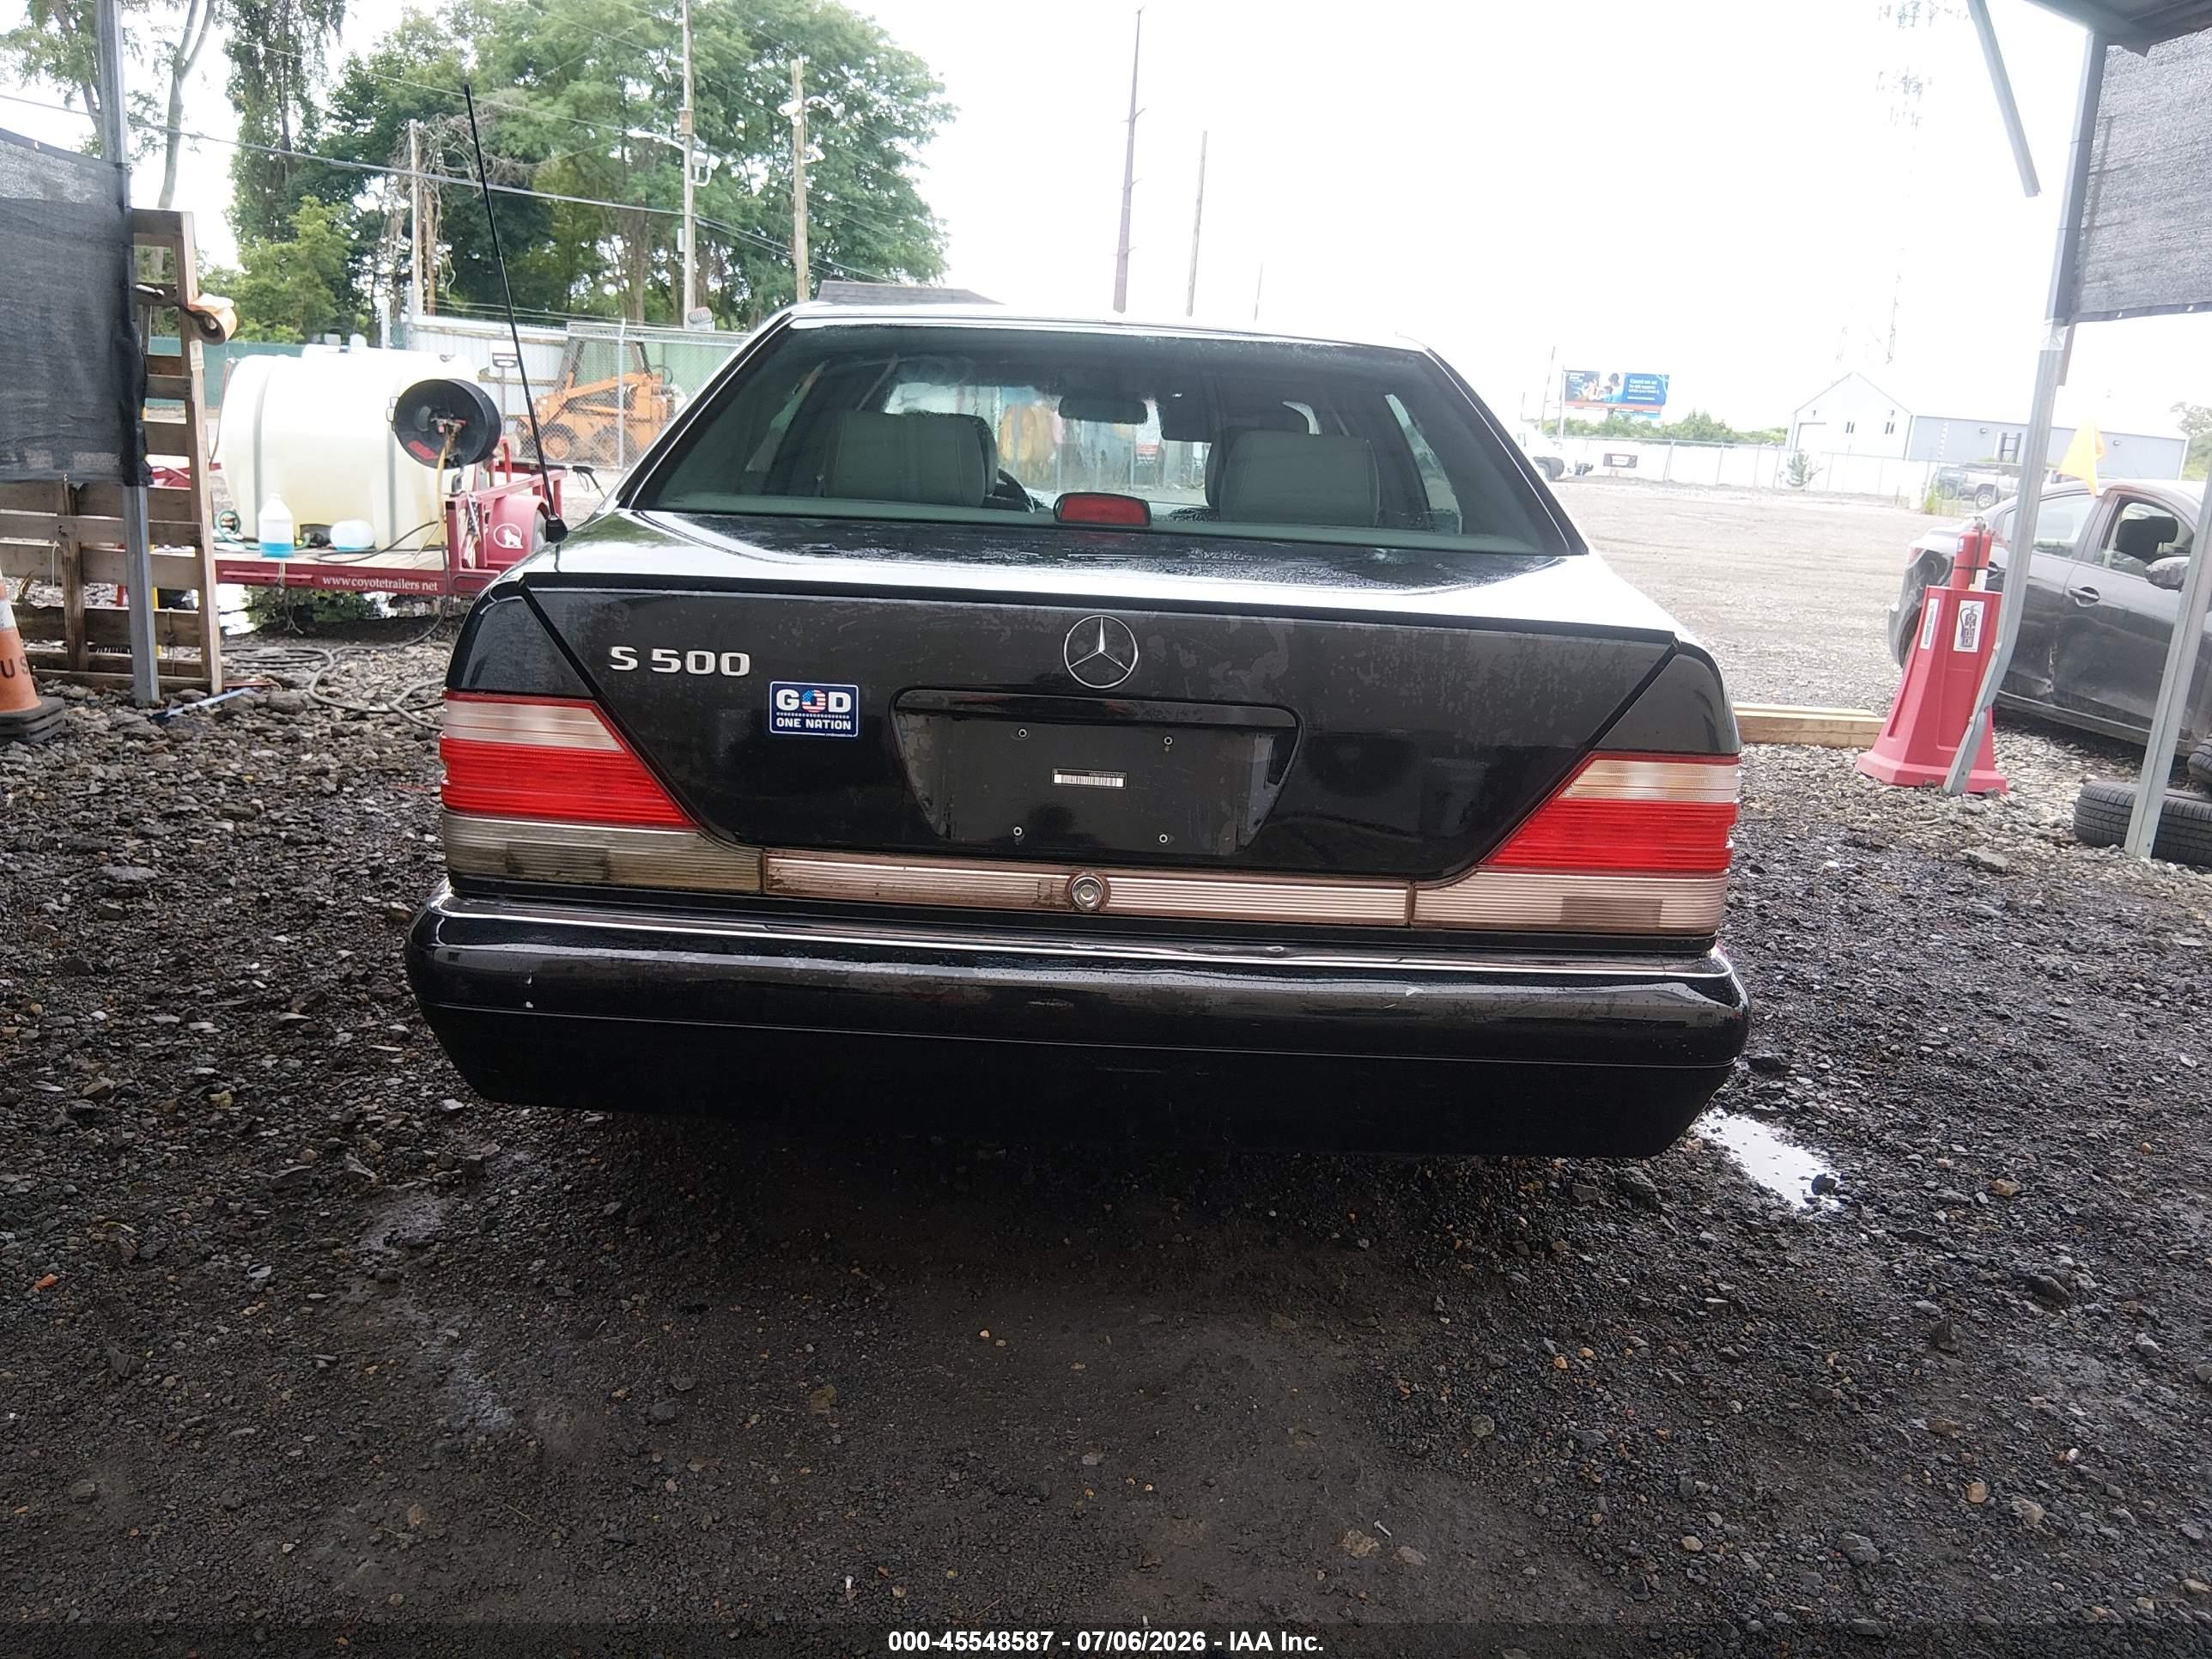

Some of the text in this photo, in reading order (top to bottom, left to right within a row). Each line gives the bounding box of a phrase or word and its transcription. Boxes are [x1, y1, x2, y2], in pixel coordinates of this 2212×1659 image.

[322, 576, 438, 592] wwwcoyotetrailersnet
[609, 646, 750, 677] S 500
[776, 689, 851, 713] GOD
[776, 717, 852, 731] ONE NATION
